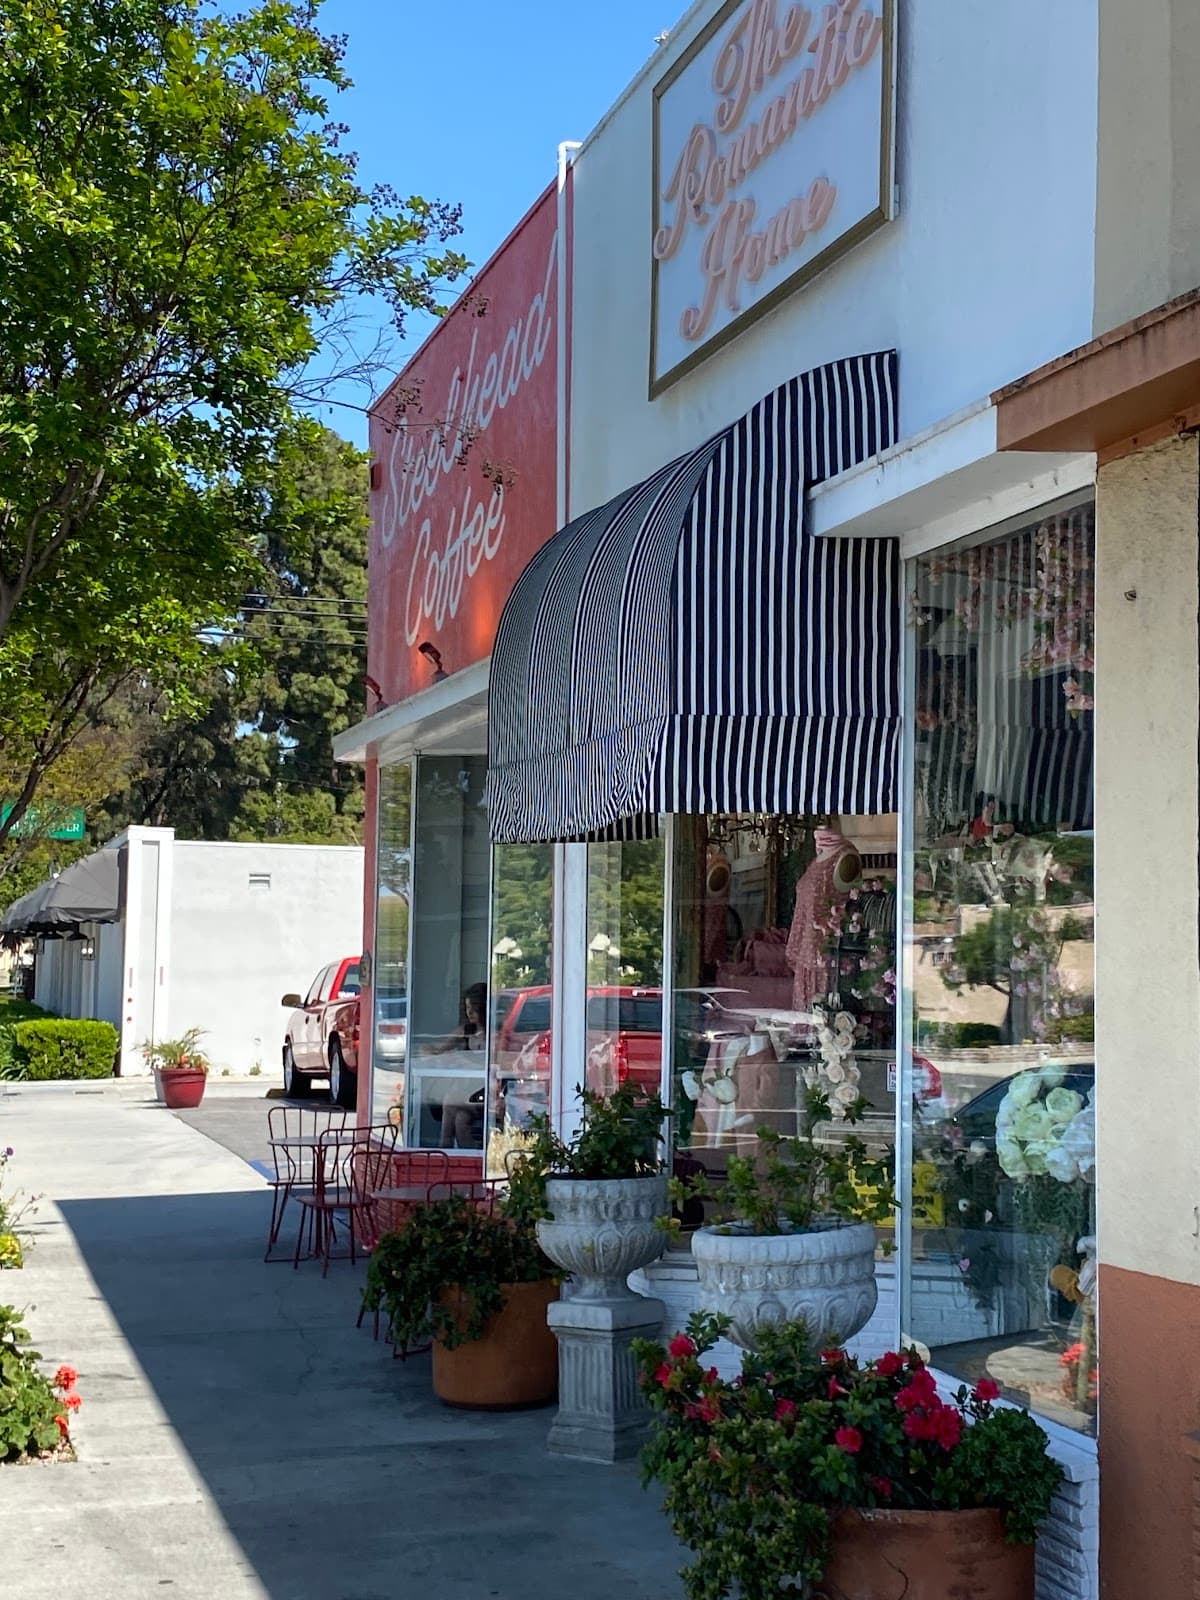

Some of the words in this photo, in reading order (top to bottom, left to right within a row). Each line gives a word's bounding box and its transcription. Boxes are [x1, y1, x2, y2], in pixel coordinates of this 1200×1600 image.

[654, 0, 882, 260] Romantic
[712, 0, 811, 133] The
[680, 177, 837, 340] Home
[382, 228, 558, 547] Steelhead
[406, 484, 505, 647] Coffee
